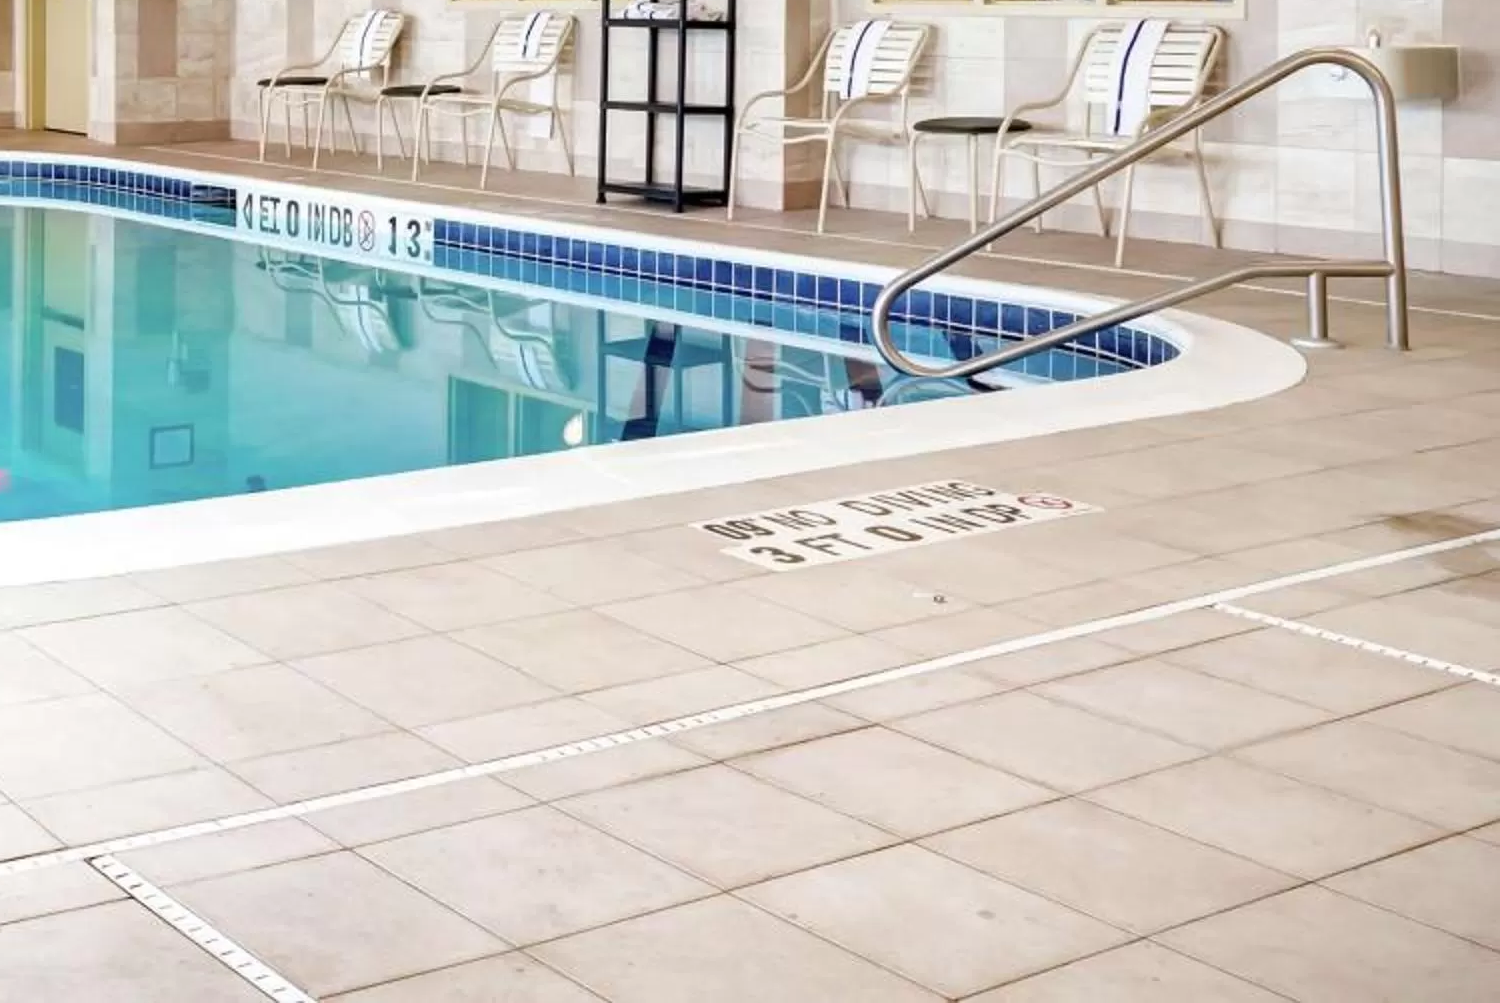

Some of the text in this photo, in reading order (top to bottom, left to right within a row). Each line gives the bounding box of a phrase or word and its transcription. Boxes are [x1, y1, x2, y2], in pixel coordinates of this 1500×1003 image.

[762, 509, 837, 531] NO
[838, 481, 996, 516] DIVING
[749, 546, 806, 564] 3
[793, 532, 873, 556] FT
[864, 525, 924, 542] 0
